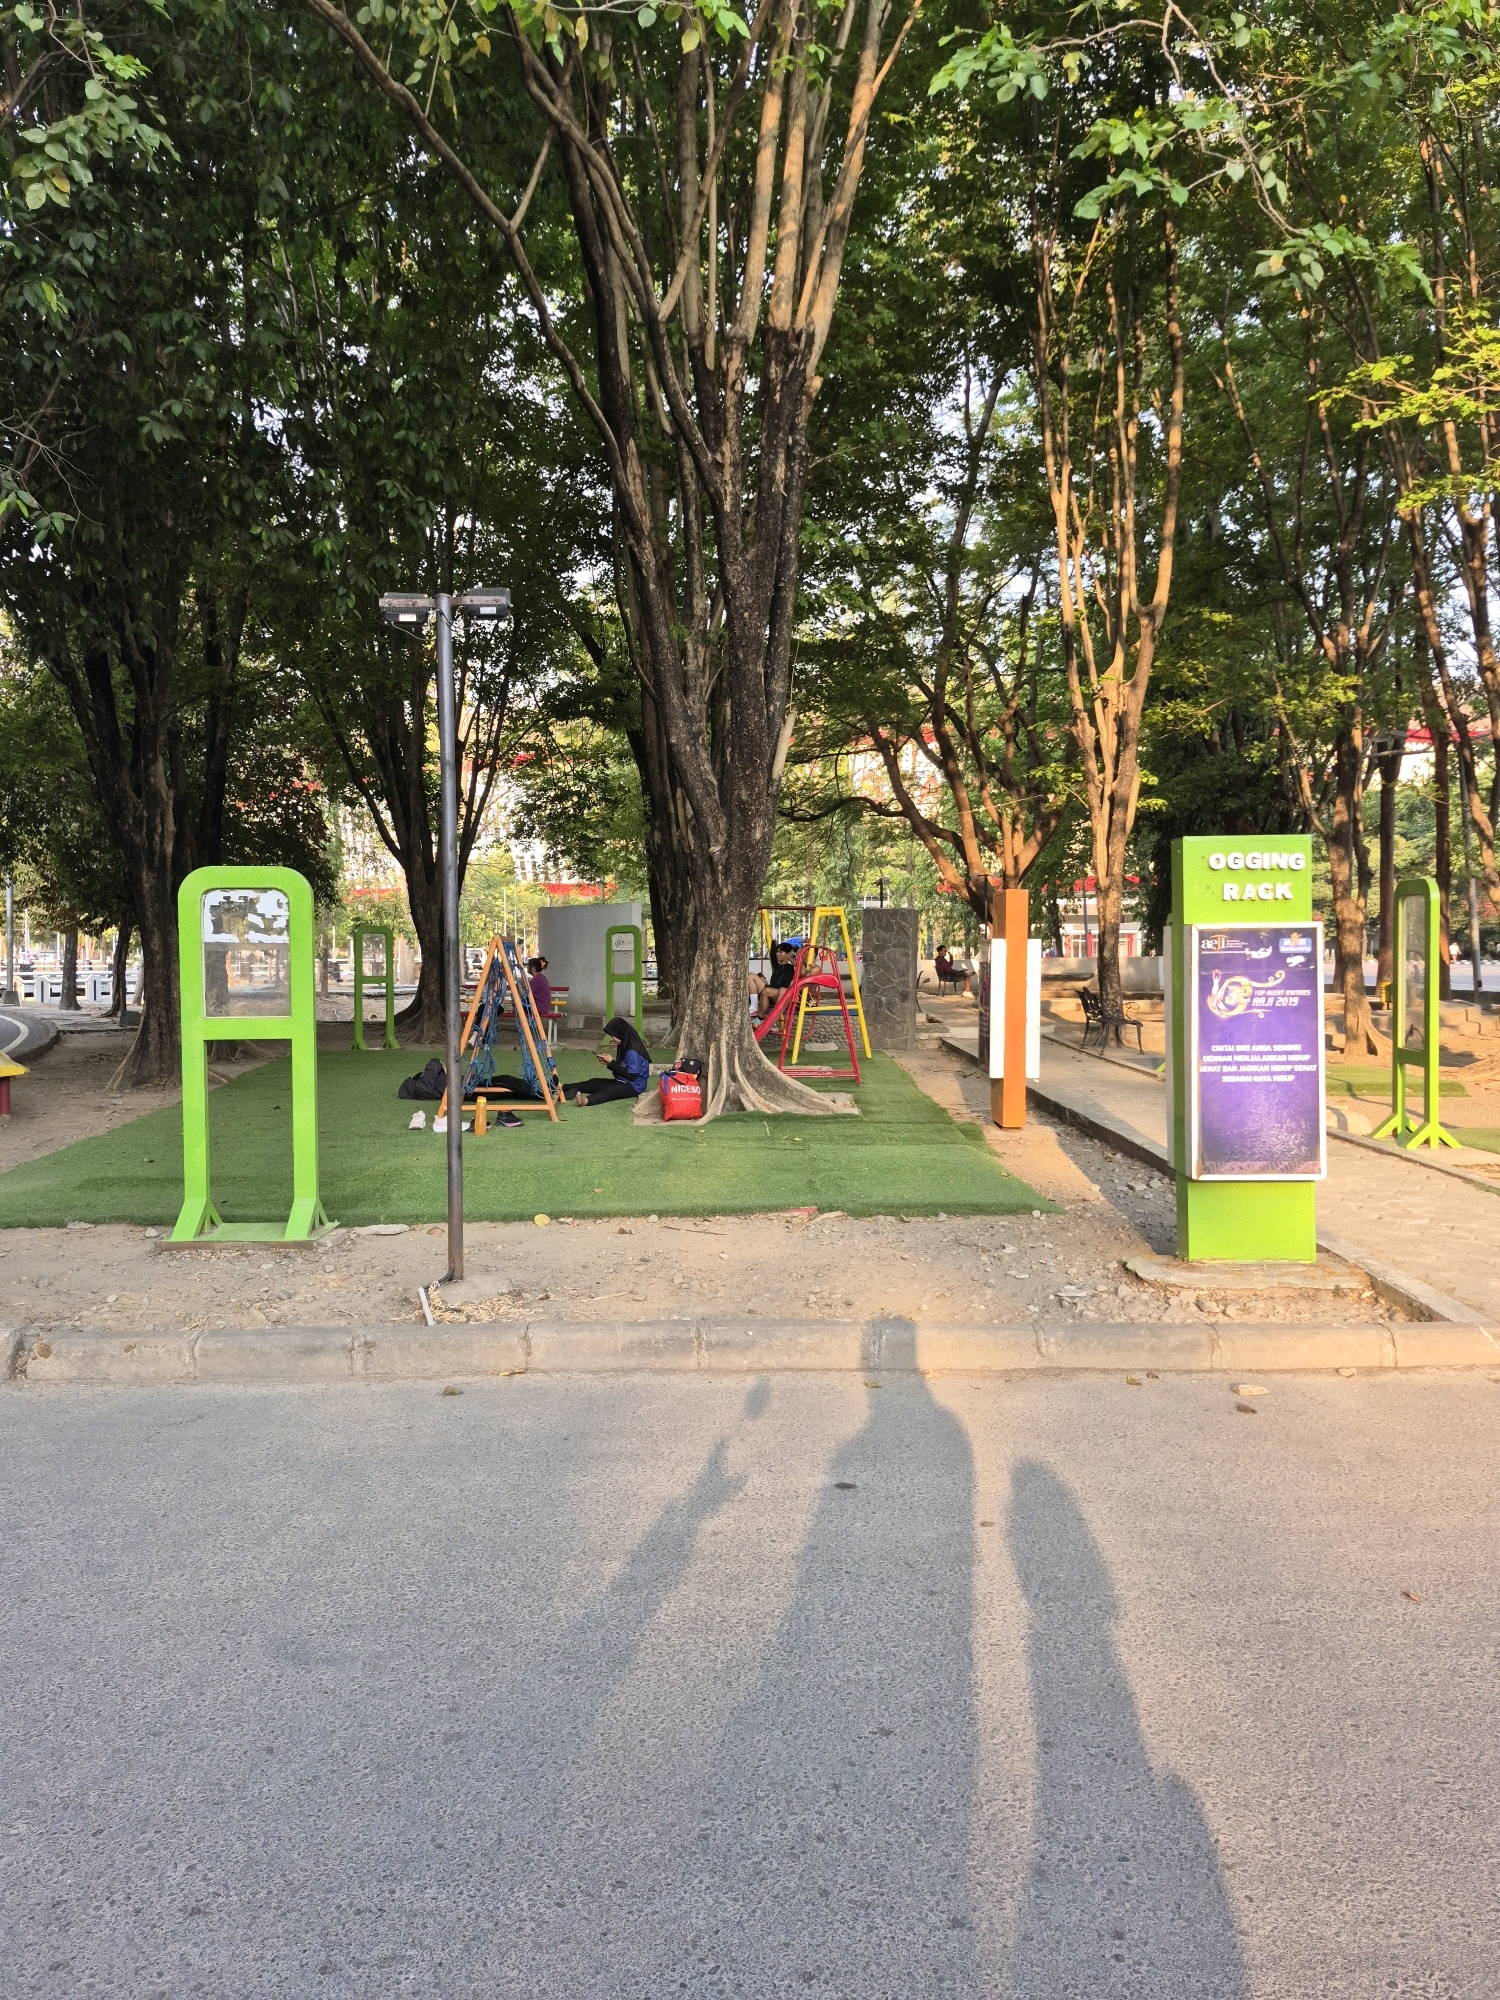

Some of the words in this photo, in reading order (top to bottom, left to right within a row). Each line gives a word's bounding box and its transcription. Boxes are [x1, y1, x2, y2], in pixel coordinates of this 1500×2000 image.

[1208, 852, 1306, 870] OGGING
[1222, 882, 1293, 901] RACK
[1275, 997, 1299, 1006] 2019
[670, 1084, 701, 1095] NICESO
